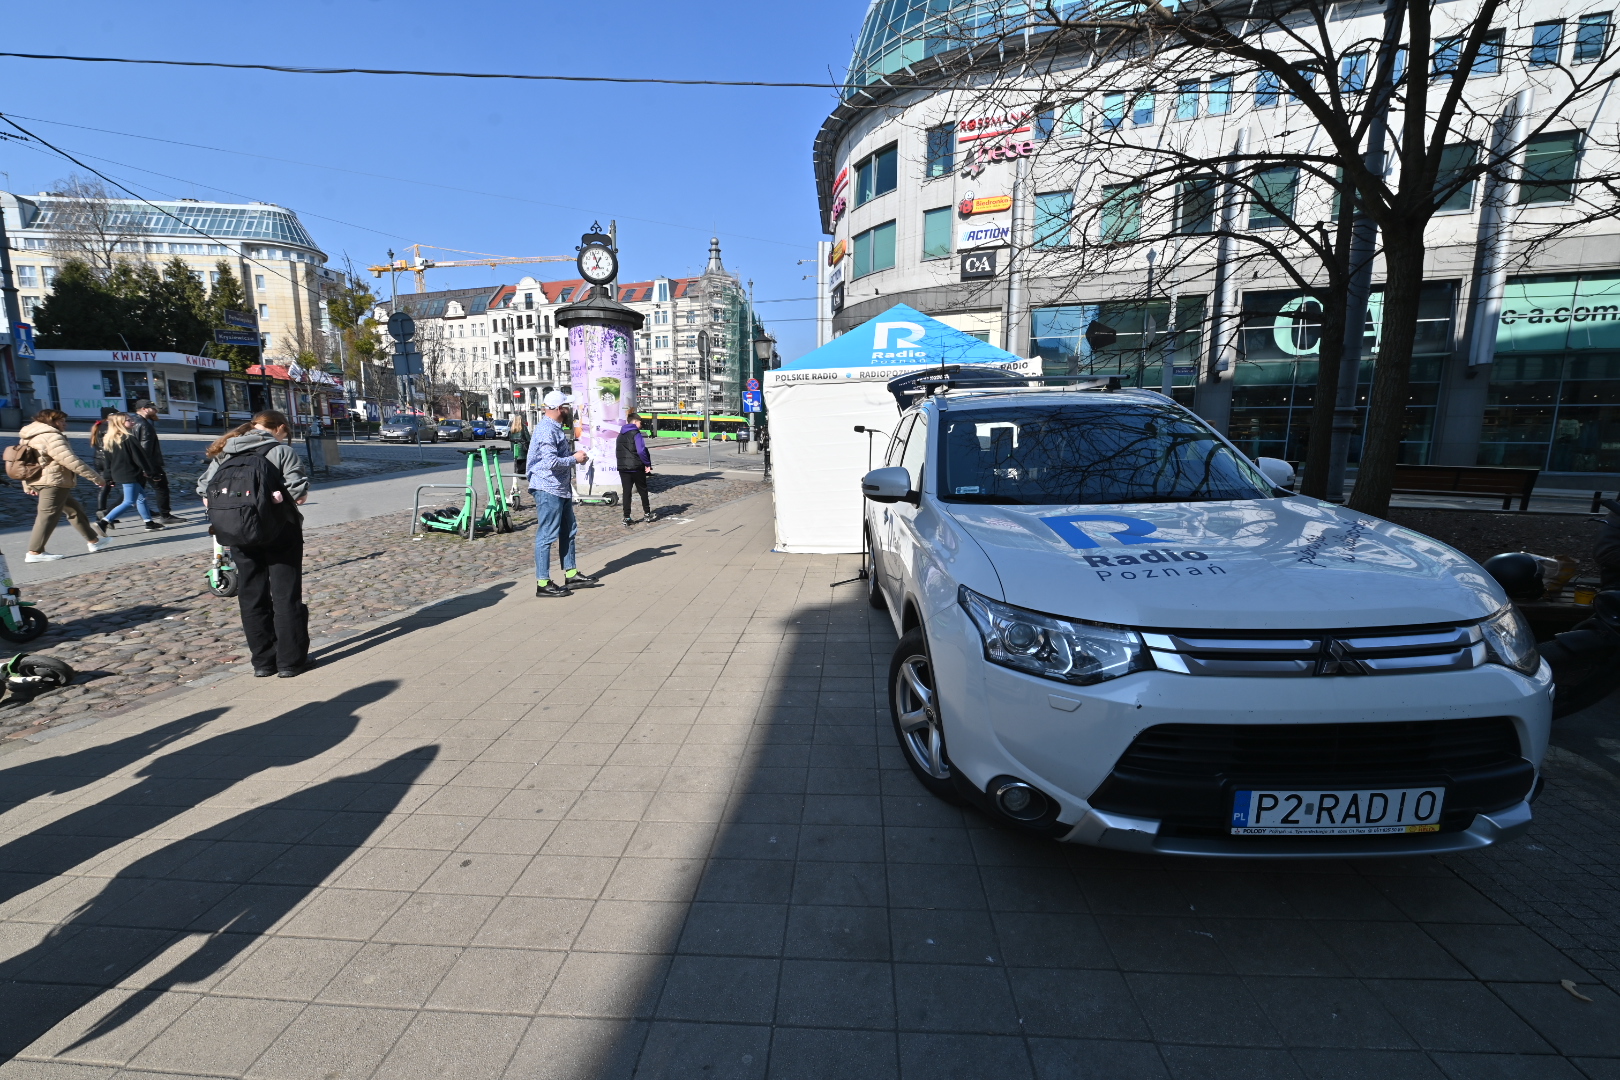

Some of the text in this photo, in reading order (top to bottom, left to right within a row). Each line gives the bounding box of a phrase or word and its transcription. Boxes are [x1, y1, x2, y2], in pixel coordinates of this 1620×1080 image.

[978, 137, 1034, 163] hebe
[976, 199, 1009, 207] Biedronka
[967, 227, 1010, 241] ACTION
[965, 256, 992, 273] C&A
[1501, 305, 1620, 325] c-a.com
[112, 351, 157, 361] KWIATY
[872, 350, 926, 359] Radio
[185, 355, 216, 368] KWIATY
[1000, 361, 1029, 371] RADIO
[775, 372, 838, 382] POLSKIE RADIO
[74, 399, 120, 409] KWIATY
[1082, 548, 1209, 568] Radio
[1095, 563, 1227, 582] Poznań
[1254, 790, 1437, 825] P2 RADIO
[1233, 812, 1246, 821] PL
